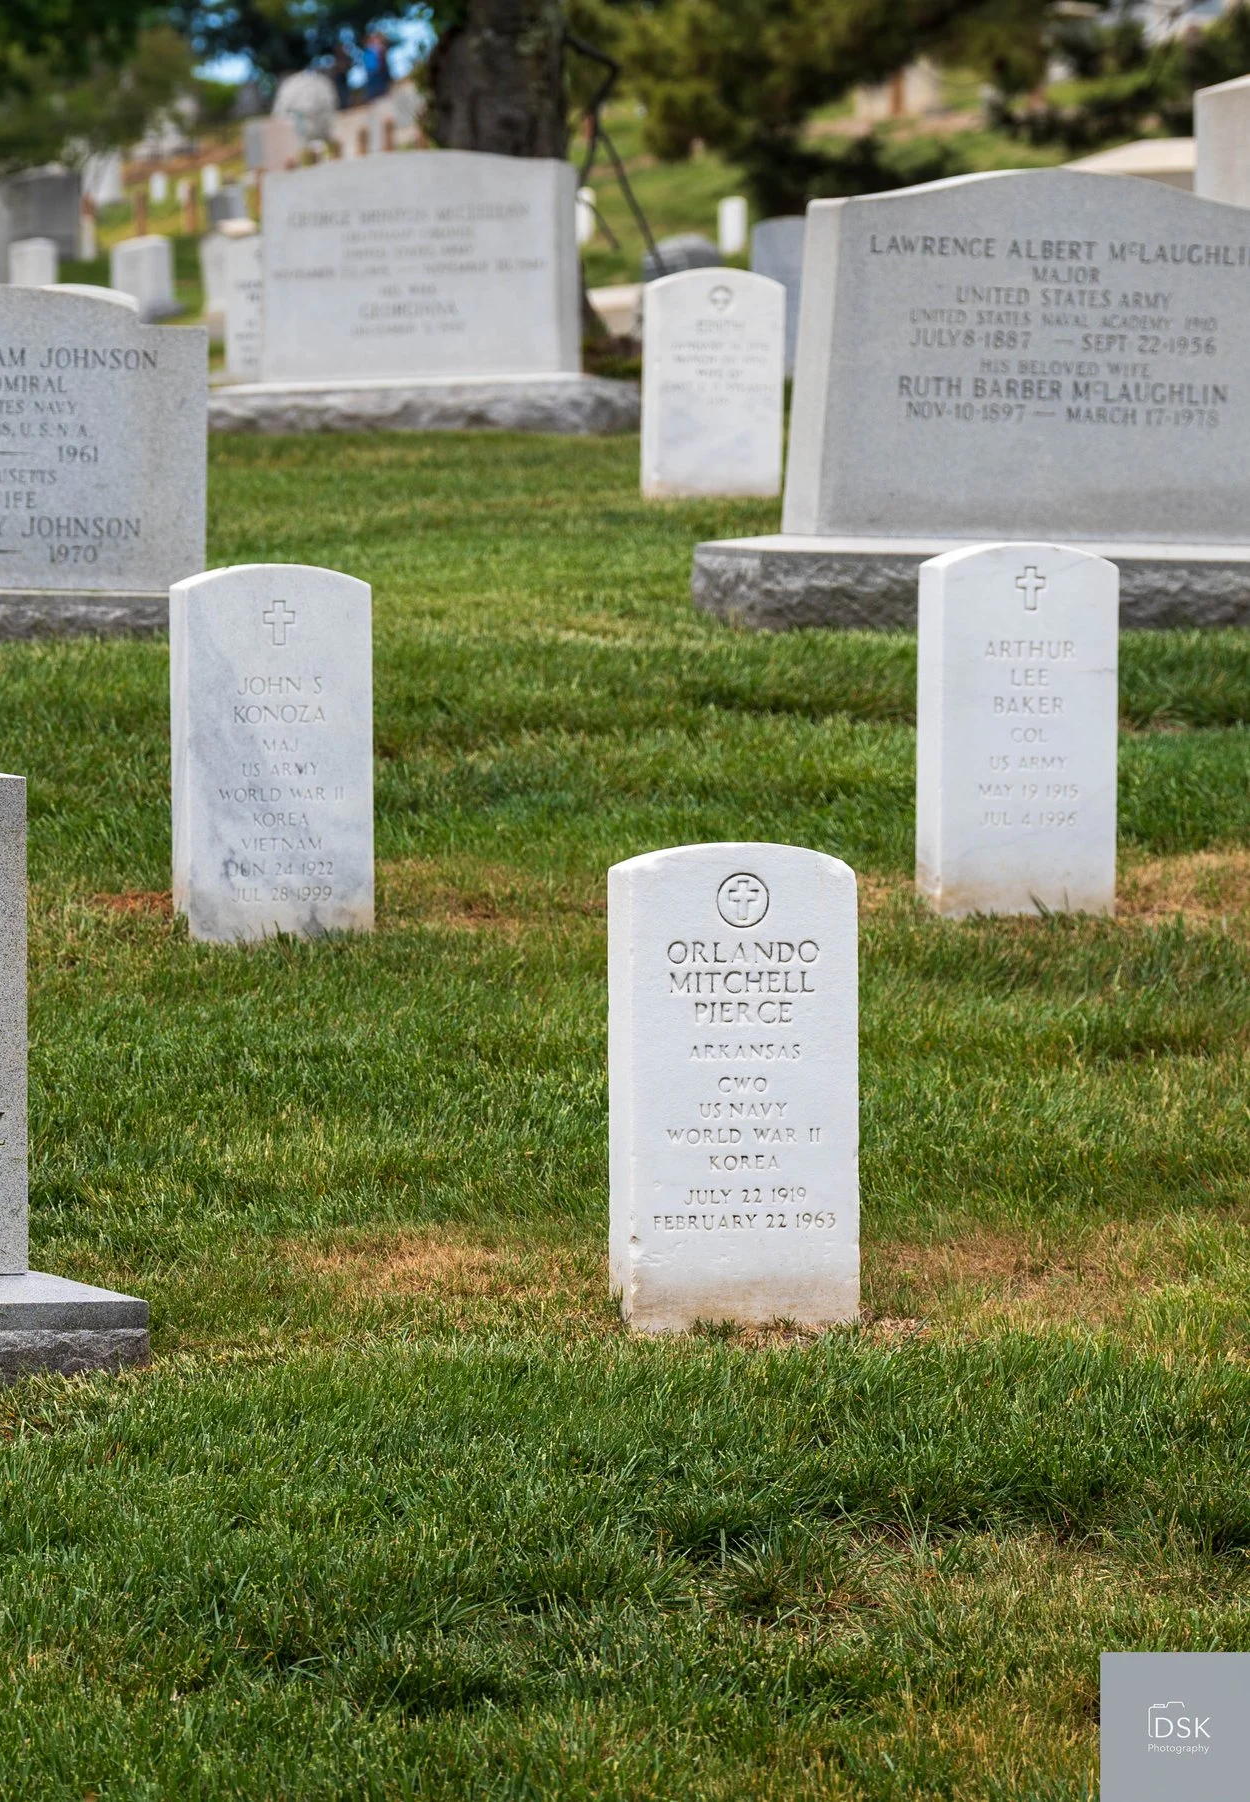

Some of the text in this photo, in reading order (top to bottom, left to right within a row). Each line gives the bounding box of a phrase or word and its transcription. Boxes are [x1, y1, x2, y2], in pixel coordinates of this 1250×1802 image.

[869, 234, 1250, 267] LAWRENCE ALBERT McLAUGHLI
[1032, 266, 1101, 284] MAJOR
[956, 285, 1173, 311] UNITED STATES ARMY
[909, 308, 968, 325] UNITED
[976, 310, 1032, 327] STATES
[1102, 315, 1173, 331] ACADEMY
[909, 328, 961, 348] JULY
[39, 347, 159, 370] JOHNSON
[980, 358, 1152, 379] HIS BELOVED WIFE
[898, 375, 963, 398] RUTH
[973, 377, 1063, 401] BARBER
[34, 400, 78, 415] NAVY
[1066, 405, 1139, 427] MARCH
[57, 445, 99, 463] 1961
[21, 515, 141, 540] JOHNSON
[49, 543, 99, 565] 1970
[984, 640, 1075, 659] ARTHUR
[237, 675, 323, 696] JOHN S
[1011, 668, 1050, 687] LEE
[233, 704, 326, 725] KONOZA
[993, 696, 1065, 715] BAKER
[1010, 727, 1049, 744] COL
[262, 738, 300, 753] MAJ
[241, 762, 319, 778] US ARMY
[989, 756, 1069, 771] US ARMY
[218, 787, 344, 804] WORLD WAR II
[978, 783, 1079, 798] MAY 19 1915
[252, 812, 310, 828] KOREA
[980, 811, 1078, 828] JUL 4 1996
[241, 837, 323, 852] VIETNAM
[300, 861, 334, 877] 1922
[231, 886, 333, 903] JUL 28 1999
[666, 939, 820, 965] ORLANDO
[669, 970, 815, 995] MITCHELL
[694, 1001, 794, 1025] PIERCE
[689, 1043, 802, 1061] ARKANSAS
[717, 1076, 769, 1093] CWO
[699, 1102, 788, 1120] US NAVY
[666, 1126, 821, 1145] WORLD WAR II
[709, 1154, 780, 1171] KOREA
[683, 1187, 807, 1205] JULY 22 1919
[653, 1212, 837, 1232] FEBRUARY 22 1963
